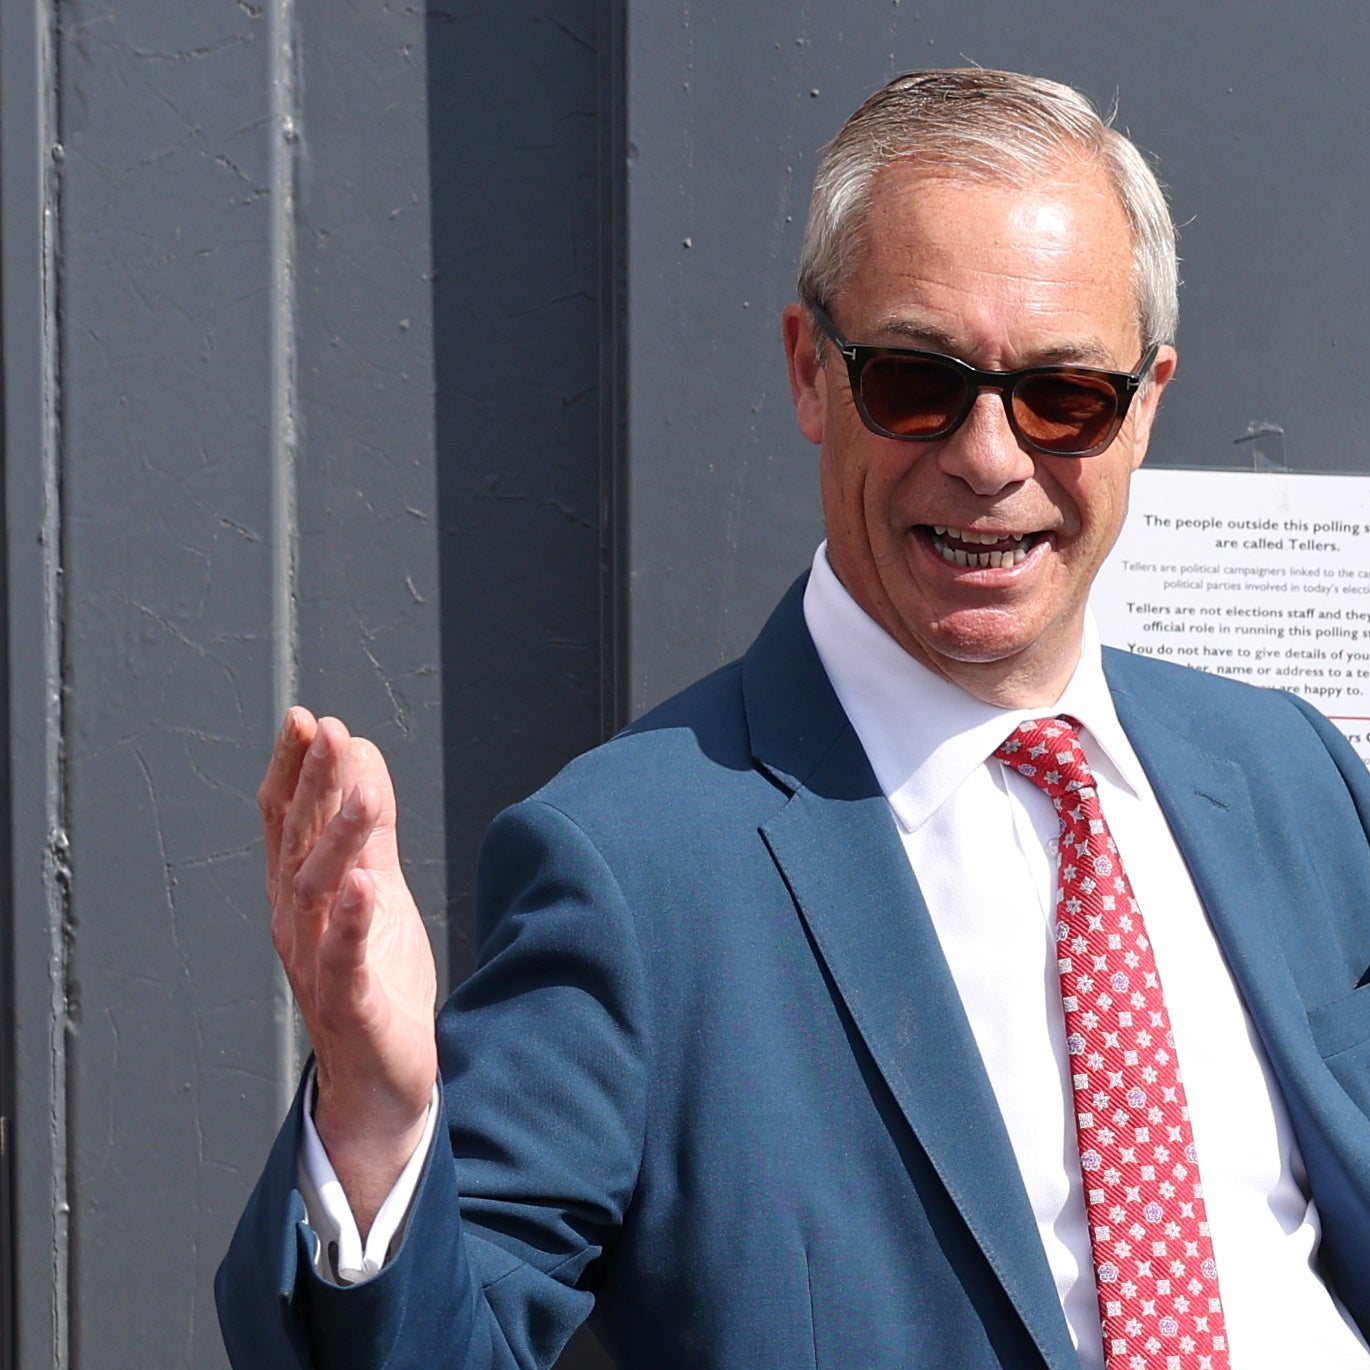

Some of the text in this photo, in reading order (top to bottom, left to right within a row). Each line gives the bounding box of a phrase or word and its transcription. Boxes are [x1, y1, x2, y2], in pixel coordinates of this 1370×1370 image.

[1144, 514, 1171, 527] The
[1175, 517, 1223, 531] people
[1227, 518, 1279, 531] outside
[1284, 520, 1309, 531] this
[1313, 521, 1360, 536] polling
[1215, 538, 1340, 552] are called Tellers.
[1122, 561, 1157, 573] Tellers
[1160, 564, 1177, 573] are
[1180, 563, 1220, 575] political
[1223, 566, 1286, 578] campaigners
[1290, 566, 1320, 577] linked
[1323, 568, 1335, 577] to
[1338, 568, 1354, 578] the
[1163, 579, 1203, 591] political
[1206, 580, 1241, 592] parties
[1245, 581, 1287, 592] involved
[1291, 583, 1300, 591] in
[1303, 583, 1339, 596] today's
[1126, 602, 1170, 614] Tellers
[1175, 606, 1196, 615] are
[1200, 606, 1222, 616] not
[1226, 605, 1284, 618] elections
[1287, 608, 1315, 619] staff
[1318, 609, 1341, 620] and
[1143, 621, 1185, 633] official
[1190, 622, 1214, 634] role
[1219, 623, 1230, 634] in
[1235, 625, 1285, 638] running
[1289, 625, 1311, 637] this
[1315, 627, 1358, 640] polling
[1127, 642, 1153, 654] You
[1157, 644, 1173, 655] do
[1178, 646, 1199, 656] not
[1203, 645, 1233, 656] have
[1238, 647, 1251, 657] to
[1255, 647, 1281, 660] give
[1285, 648, 1326, 660] details
[1330, 649, 1344, 660] of
[1217, 665, 1252, 674] name
[1257, 667, 1271, 675] or
[1275, 666, 1324, 677] address
[1328, 668, 1341, 677] to
[1346, 669, 1353, 677] a
[1304, 684, 1342, 697] happy
[1346, 686, 1363, 695] to.
